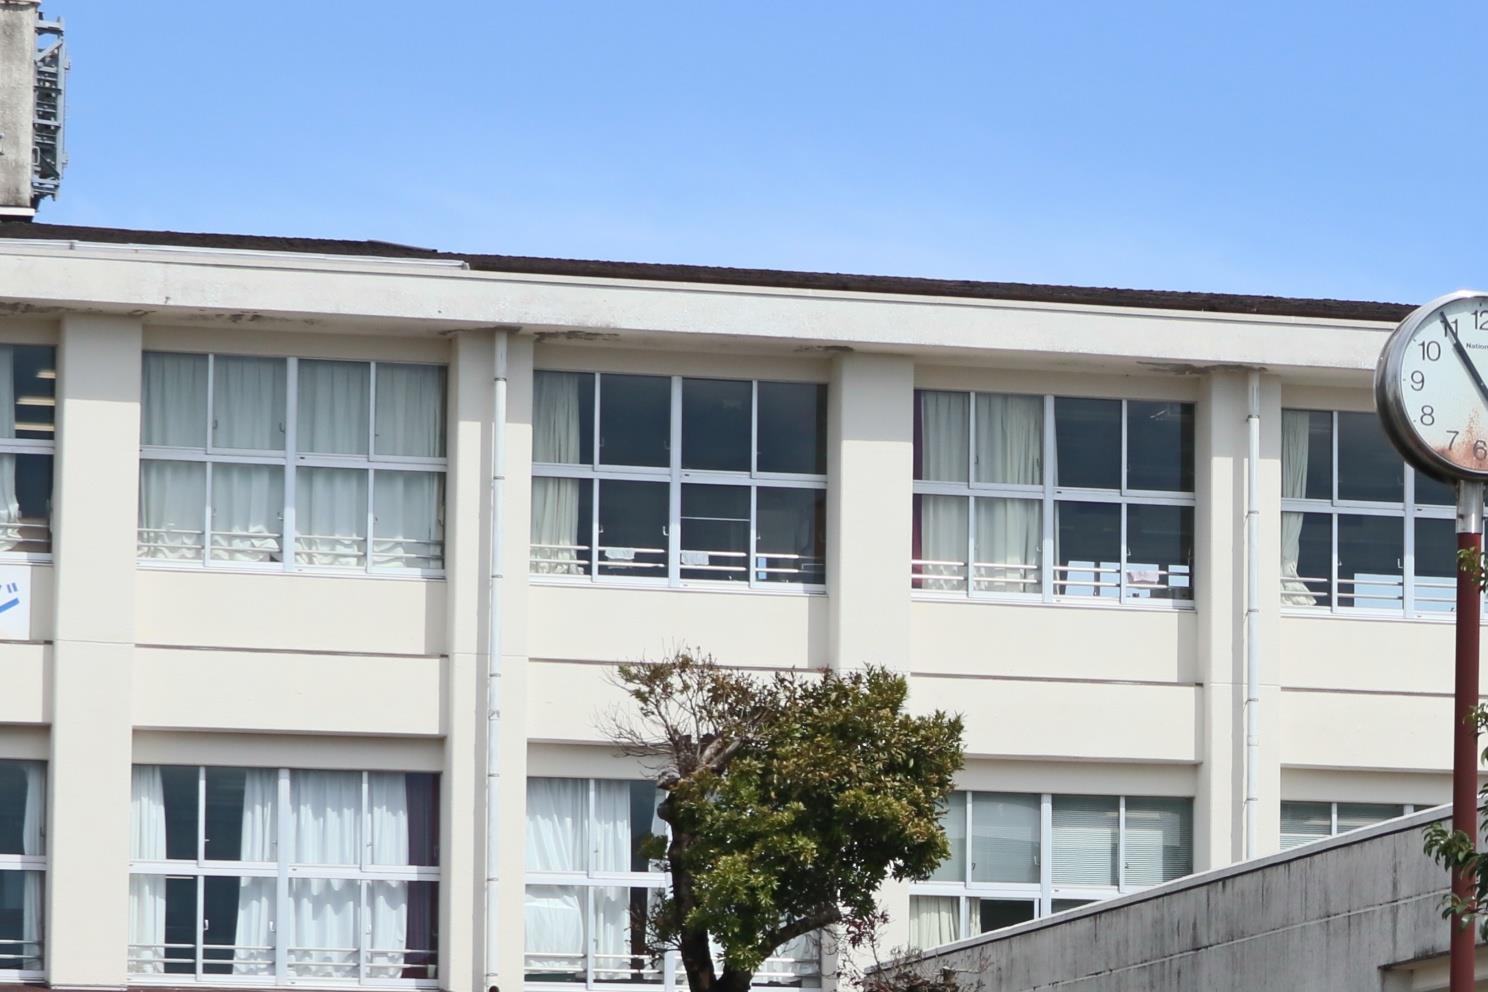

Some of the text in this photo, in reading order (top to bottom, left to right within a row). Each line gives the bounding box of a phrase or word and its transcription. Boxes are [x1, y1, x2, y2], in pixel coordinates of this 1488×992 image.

[1440, 319, 1459, 338] 11
[1418, 341, 1441, 361] 10
[1410, 370, 1425, 391] 9
[1420, 405, 1435, 426] 8
[1446, 430, 1459, 450] 7
[1473, 440, 1488, 461] 6
